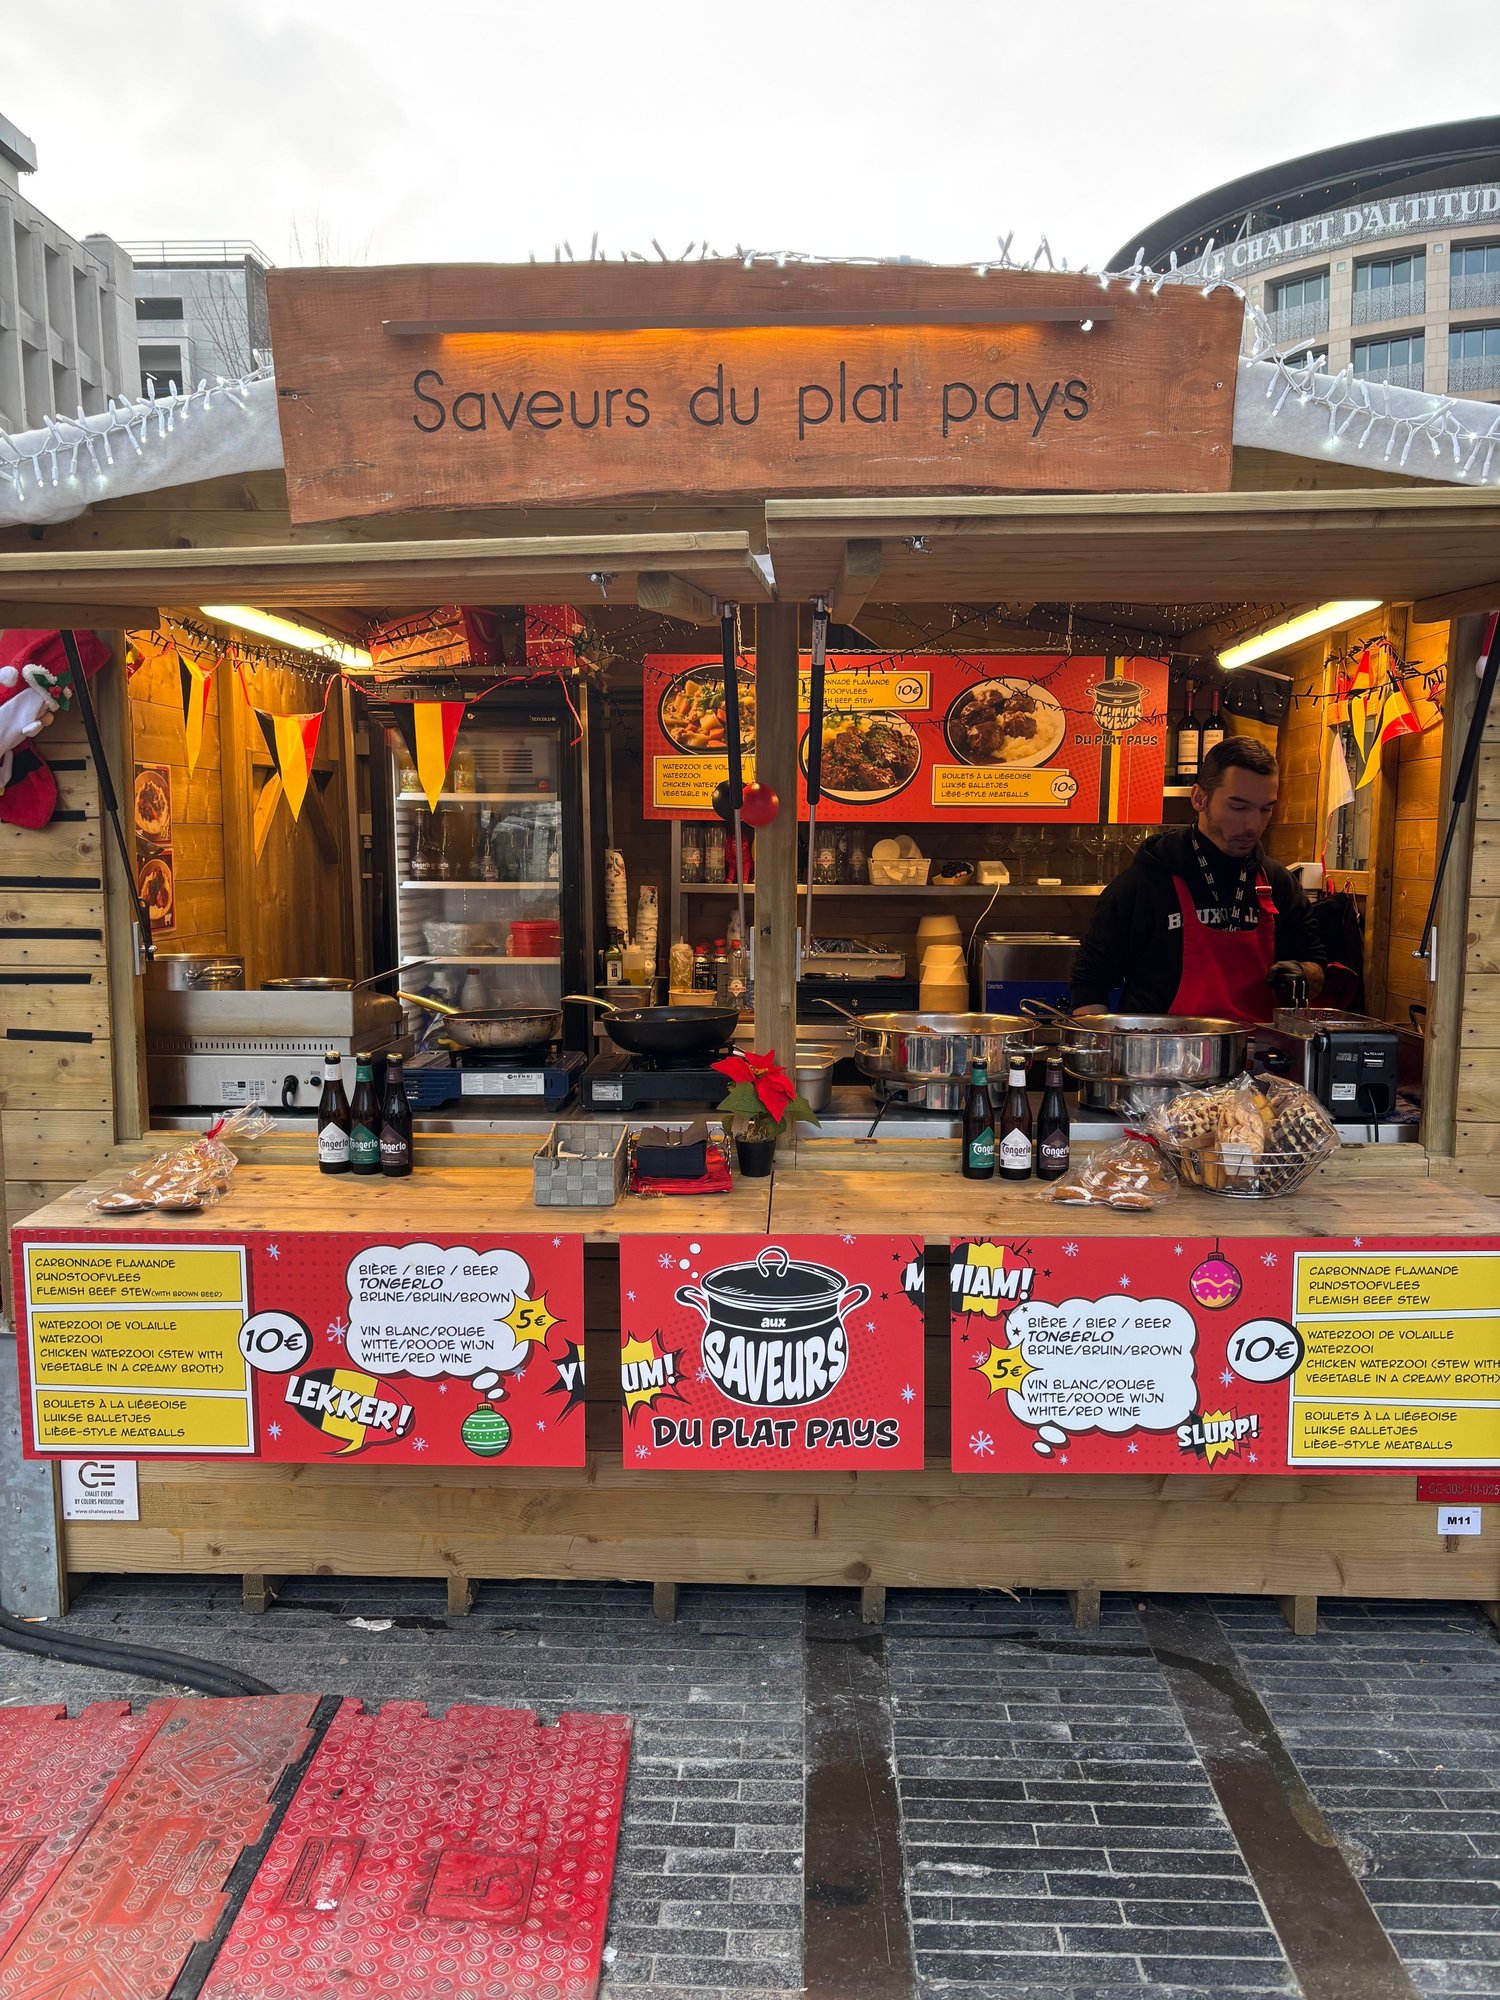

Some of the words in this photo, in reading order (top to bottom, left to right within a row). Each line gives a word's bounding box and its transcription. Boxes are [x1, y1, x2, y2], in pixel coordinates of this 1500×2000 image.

[1232, 217, 1336, 267] CHALET
[1342, 188, 1500, 236] D'ALTITUD
[413, 369, 650, 433] Saveurs
[690, 363, 760, 426] du
[799, 361, 903, 440] plat
[943, 380, 1088, 438] pays
[898, 685, 919, 695] 10€
[1075, 735, 1091, 745] DU
[1094, 735, 1123, 745] PLAT
[1127, 735, 1158, 745] PAYS
[1054, 782, 1075, 792] 10€
[319, 1138, 349, 1150] Tongerlo
[35, 1258, 112, 1268] CARBONNADE
[116, 1259, 175, 1268] FLAMANDE
[359, 1263, 397, 1275] BIÈRE
[403, 1264, 410, 1275] /
[415, 1265, 445, 1275] BIER
[450, 1264, 458, 1275] /
[463, 1265, 498, 1276] BEER
[1310, 1266, 1391, 1275] CARBONNADE
[1396, 1266, 1458, 1275] FLAMANDE
[36, 1273, 140, 1282] RUNDSTOOFVLEES
[360, 1278, 443, 1289] TONGERLO
[1310, 1281, 1420, 1290] RUNDSTOOFVLEES
[37, 1287, 84, 1295] FLEMISH
[89, 1287, 116, 1296] BEEF
[360, 1292, 510, 1303] BRUNE/BRUIN/BROWN
[1309, 1296, 1358, 1304] FLEMISH
[1363, 1296, 1393, 1304] BEEF
[1398, 1296, 1430, 1304] STEW
[516, 1309, 546, 1329] 5€
[760, 1316, 787, 1328] aux
[1028, 1316, 1067, 1328] BIÈRE
[1072, 1318, 1080, 1328] /
[1085, 1318, 1116, 1328] BIER
[1122, 1318, 1130, 1328] /
[1134, 1318, 1171, 1329] BEER
[39, 1321, 102, 1329] WATERZOOI
[107, 1321, 121, 1329] DE
[125, 1321, 176, 1330] VOLAILLE
[360, 1326, 380, 1336] VIN
[385, 1326, 485, 1337] BLANC/ROUGE
[1028, 1331, 1114, 1342] TONGERLO
[1308, 1330, 1374, 1339] WATERZOOI
[1379, 1331, 1394, 1339] DE
[1399, 1331, 1454, 1339] VOLAILLE
[40, 1335, 102, 1343] WATERZOOI
[245, 1328, 303, 1353] 10€
[361, 1339, 456, 1350] WITTE/ROODE
[460, 1340, 494, 1350] WIJN
[1233, 1337, 1295, 1362] 10€
[1307, 1344, 1373, 1354] WATERZOOI
[40, 1349, 87, 1357] CHICKEN
[91, 1349, 154, 1358] WATERZOOI
[158, 1350, 194, 1359] (STEW
[1028, 1345, 1182, 1355] BRUNE/BRUIN/BROWN
[361, 1352, 435, 1363] WHITE/RED
[439, 1353, 472, 1363] WINE
[41, 1363, 103, 1371] VEGETABLE
[133, 1364, 177, 1372] CREAMY
[181, 1364, 223, 1373] BROTH)
[704, 1327, 846, 1402] SAVEURS
[992, 1358, 1023, 1378] 5€
[1306, 1360, 1356, 1368] CHICKEN
[1360, 1360, 1427, 1368] WATERZOOI
[1431, 1360, 1470, 1369] (STEW
[1474, 1360, 1500, 1368] WITH
[622, 1353, 675, 1391] UM!
[1306, 1374, 1371, 1382] VEGETABLE
[1376, 1374, 1386, 1382] IN
[1391, 1374, 1398, 1382] A
[1403, 1374, 1451, 1383] CREAMY
[1455, 1374, 1500, 1383] BROTH)
[1028, 1379, 1048, 1389] VIN
[1053, 1379, 1155, 1390] BLANC/ROUGE
[1028, 1393, 1126, 1403] WITTE/ROODE
[1130, 1393, 1164, 1403] WIJN
[43, 1400, 95, 1408] BOULETS
[99, 1399, 107, 1408] À
[285, 1375, 414, 1437] LEKKER!
[1028, 1406, 1103, 1416] WHITE/RED
[1108, 1406, 1141, 1416] WINE
[1305, 1412, 1359, 1420] BOULETS
[1364, 1411, 1371, 1420] À
[1376, 1412, 1390, 1420] LA
[44, 1414, 82, 1422] LUIKSE
[87, 1414, 151, 1422] BALLETJES
[45, 1426, 117, 1436] LIÈGE-STYLE
[121, 1428, 185, 1437] MEATBALLS
[652, 1418, 701, 1447] DU
[710, 1418, 796, 1447] PLAT
[806, 1418, 899, 1448] PAYS
[1177, 1415, 1259, 1447] SLURP!
[1305, 1426, 1345, 1434] LUIKSE
[1350, 1426, 1417, 1435] BALLETJES
[1304, 1439, 1380, 1449] LIÈGE-STYLE
[1385, 1441, 1452, 1449] MEATBALLS
